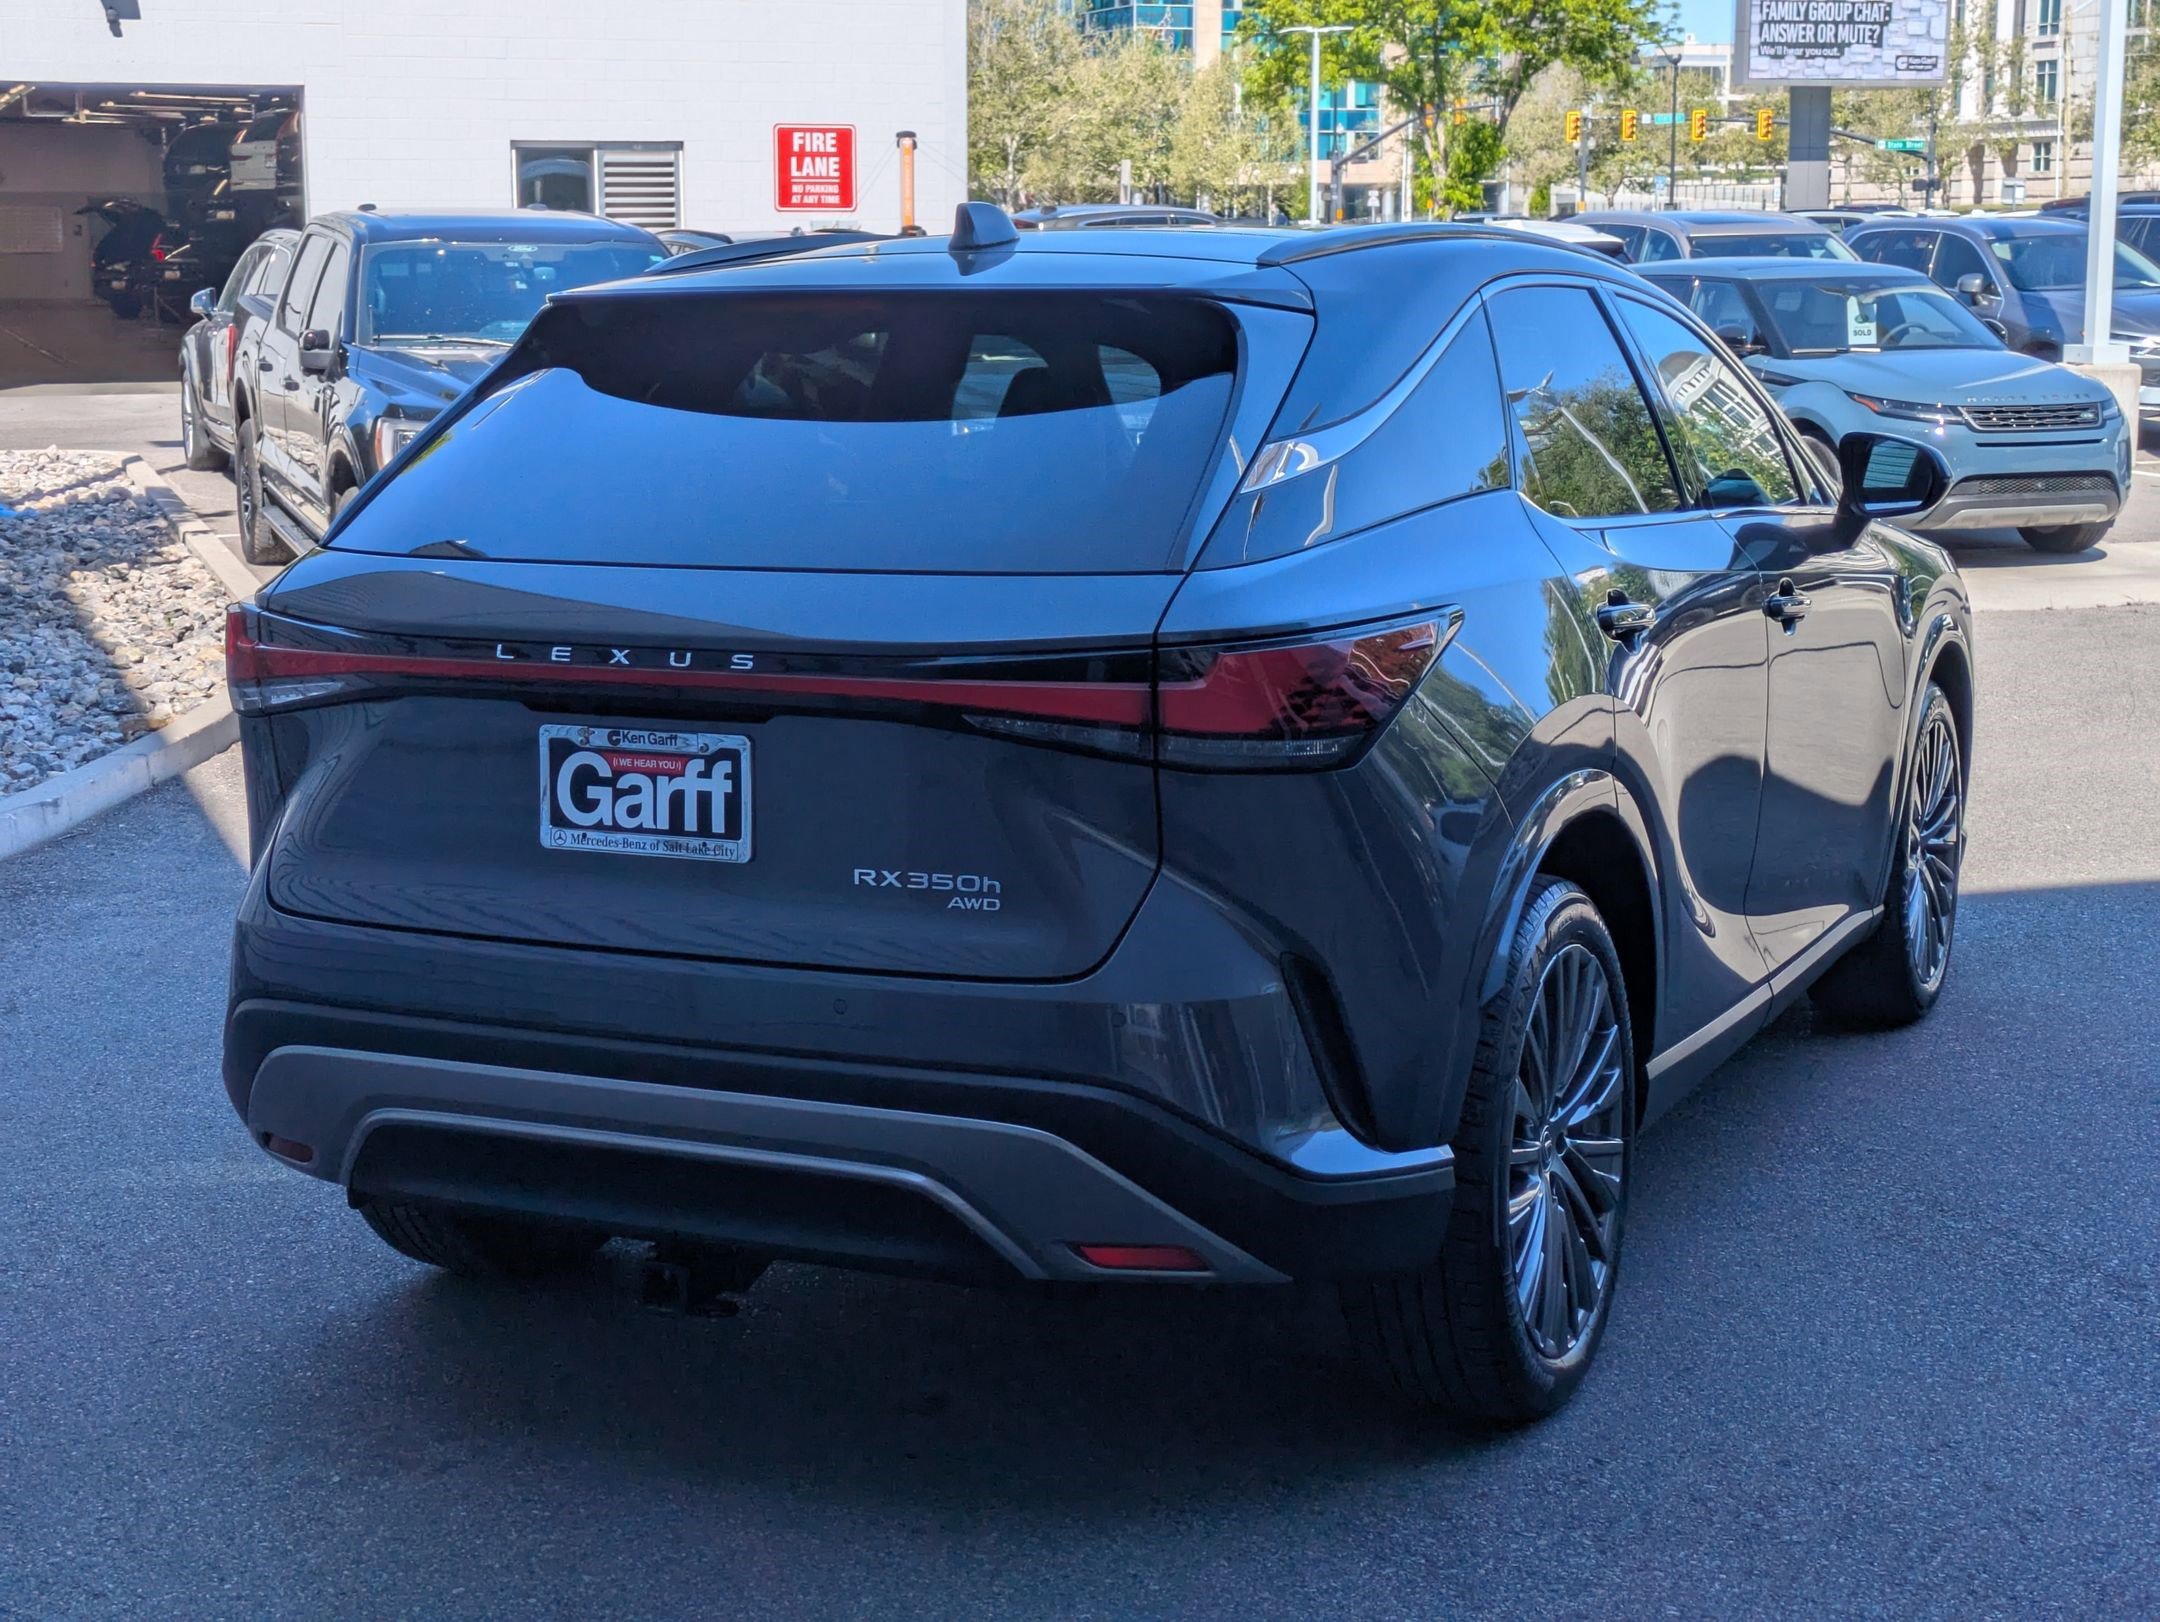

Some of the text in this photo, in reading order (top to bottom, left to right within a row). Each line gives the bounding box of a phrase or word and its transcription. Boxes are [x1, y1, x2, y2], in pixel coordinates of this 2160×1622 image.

[1761, 2, 1890, 22] FAMILY GROUP CHAT:
[1760, 23, 1881, 44] ANSWER OR MUTE?
[1760, 46, 1783, 55] We'll
[1784, 46, 1804, 56] hear
[1805, 48, 1822, 57] you
[793, 131, 837, 152] FIRE
[790, 156, 840, 177] LANE
[791, 184, 840, 193] NO PARKING
[791, 195, 840, 204] AT ANY TIME
[1853, 329, 1872, 337] SOLD
[496, 644, 754, 670] LEXUS
[622, 730, 678, 746] Ken Garff
[619, 757, 675, 769] WE HEAR YOU
[556, 750, 733, 834] Garff
[570, 833, 735, 859] Mercedes-Benz of Salt Lake City
[947, 896, 1001, 911] AWD
